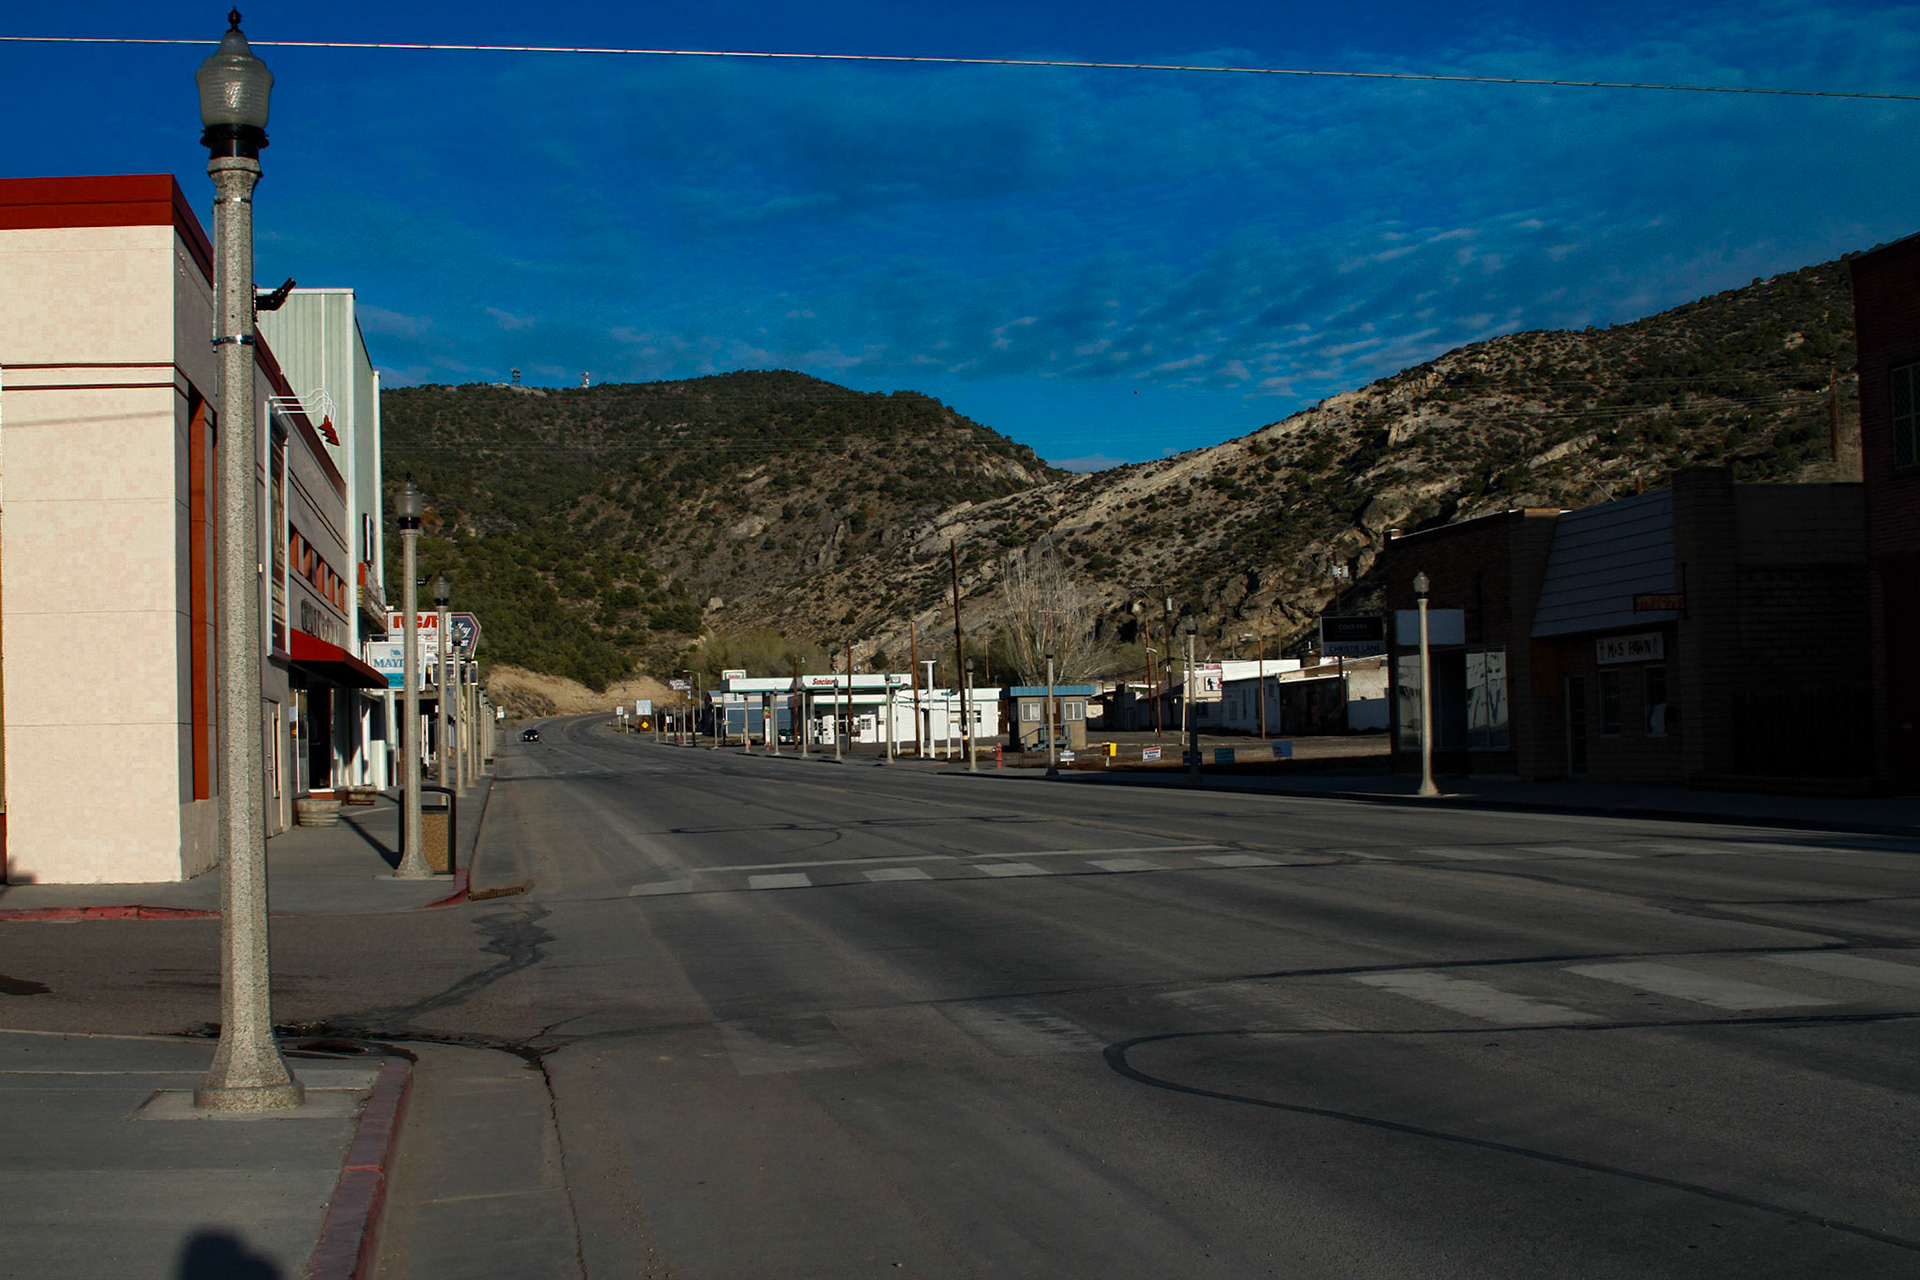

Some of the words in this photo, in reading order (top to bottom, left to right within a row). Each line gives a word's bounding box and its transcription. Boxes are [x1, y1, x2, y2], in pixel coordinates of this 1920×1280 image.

[1328, 645, 1360, 653] CHRISTIE
[1361, 644, 1381, 652] LANE
[1628, 639, 1651, 656] PAWN
